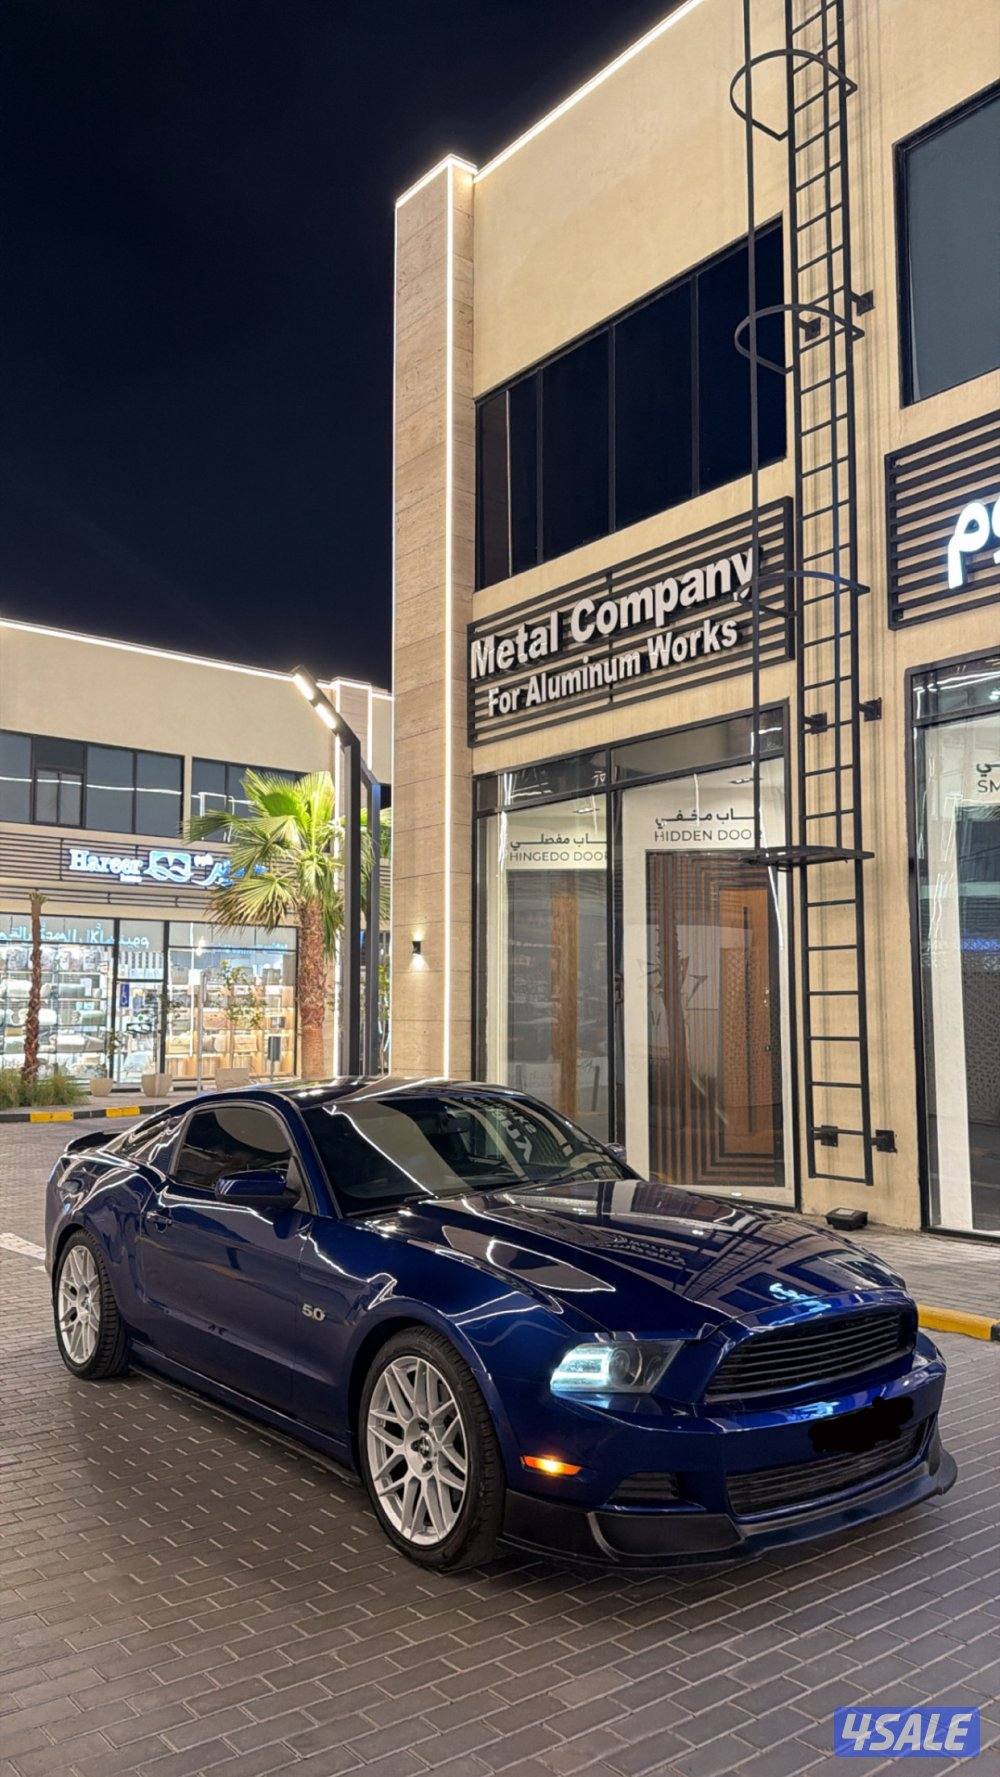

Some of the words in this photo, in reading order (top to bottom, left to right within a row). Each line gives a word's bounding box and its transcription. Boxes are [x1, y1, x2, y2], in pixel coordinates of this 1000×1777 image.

[470, 611, 560, 680] Metal
[569, 546, 754, 628] Company
[488, 684, 521, 718] For
[525, 651, 642, 708] Aluminum
[646, 617, 739, 671] Works
[655, 808, 713, 830] مخفي
[510, 833, 570, 851] مفصلي
[654, 829, 713, 842] HIDDEN
[717, 828, 763, 841] DOO
[509, 851, 570, 862] HINGEDO
